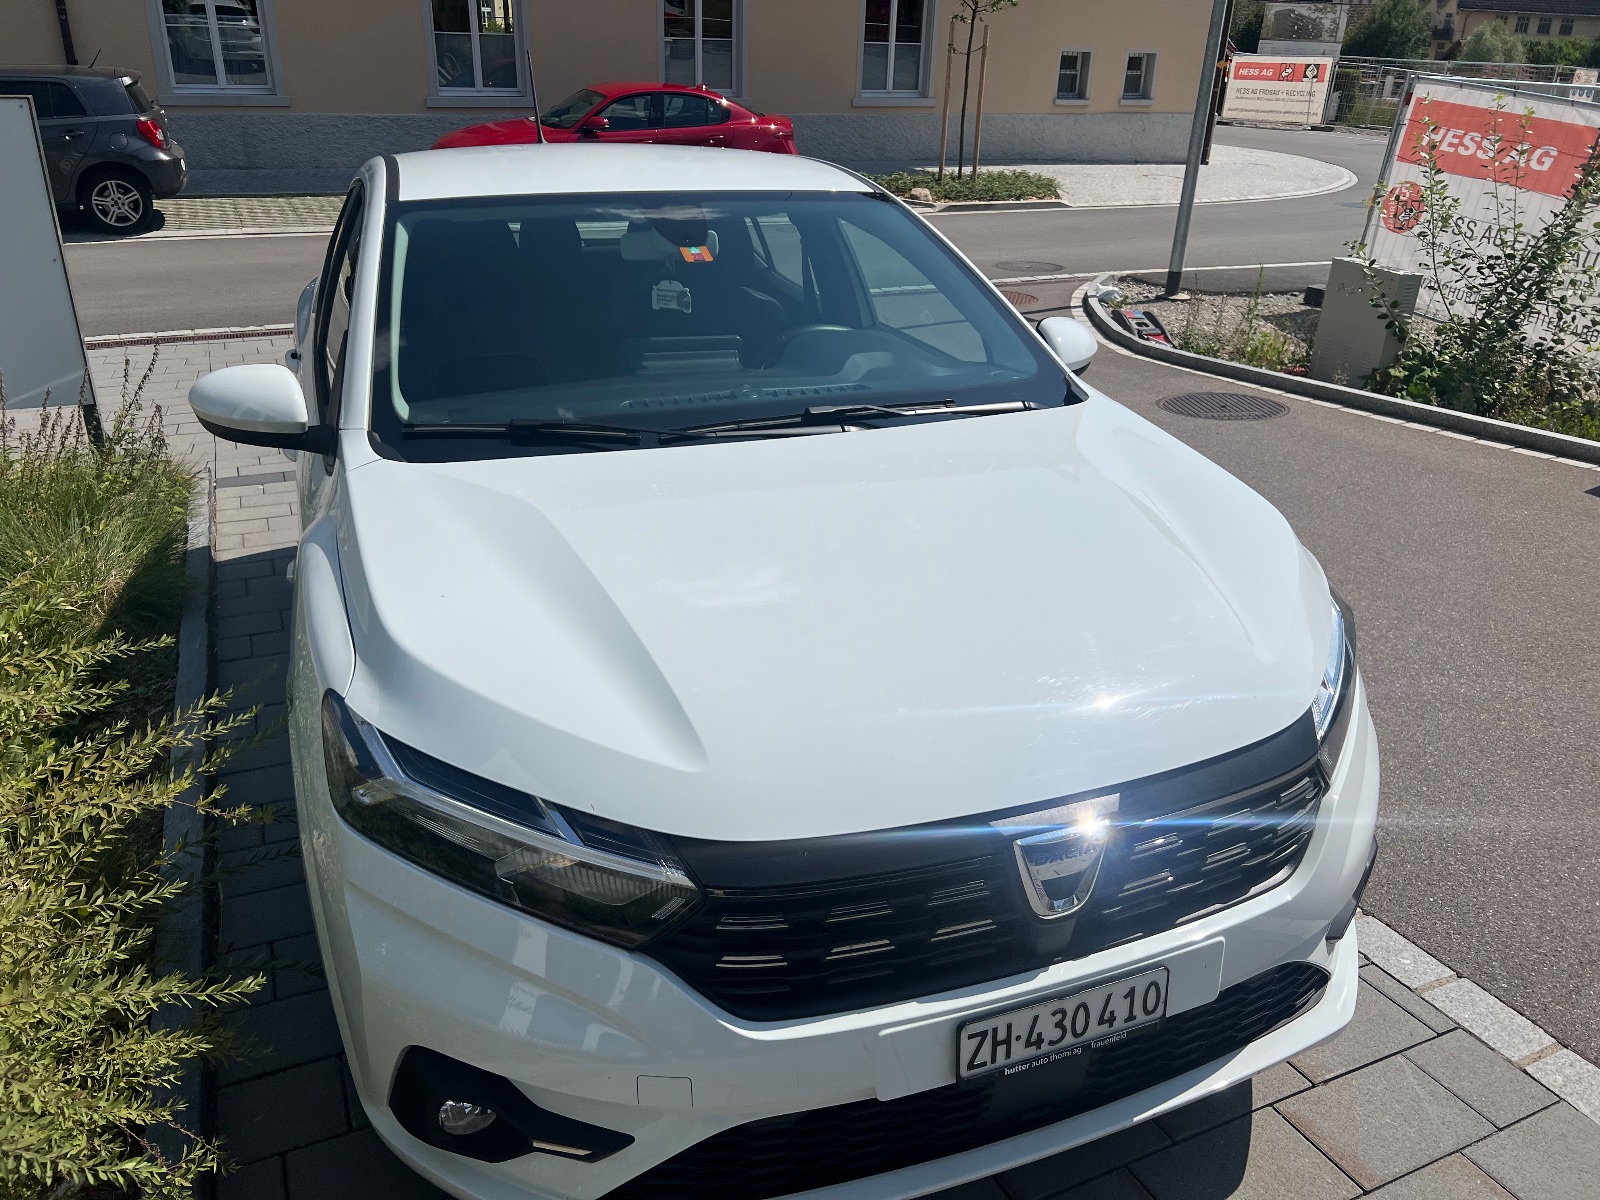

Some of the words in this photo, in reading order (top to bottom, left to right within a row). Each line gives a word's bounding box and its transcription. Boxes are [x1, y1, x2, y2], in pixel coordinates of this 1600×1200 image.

[1238, 68, 1260, 76] HESS
[1260, 68, 1274, 76] AG
[1420, 126, 1500, 160] HESS
[1502, 141, 1558, 171] AG
[1004, 1062, 1030, 1076] hutter
[1031, 1056, 1049, 1068] auto
[1049, 1050, 1072, 1064] thomi
[1072, 1046, 1082, 1057] ag
[1090, 1030, 1128, 1049] frauenfeld
